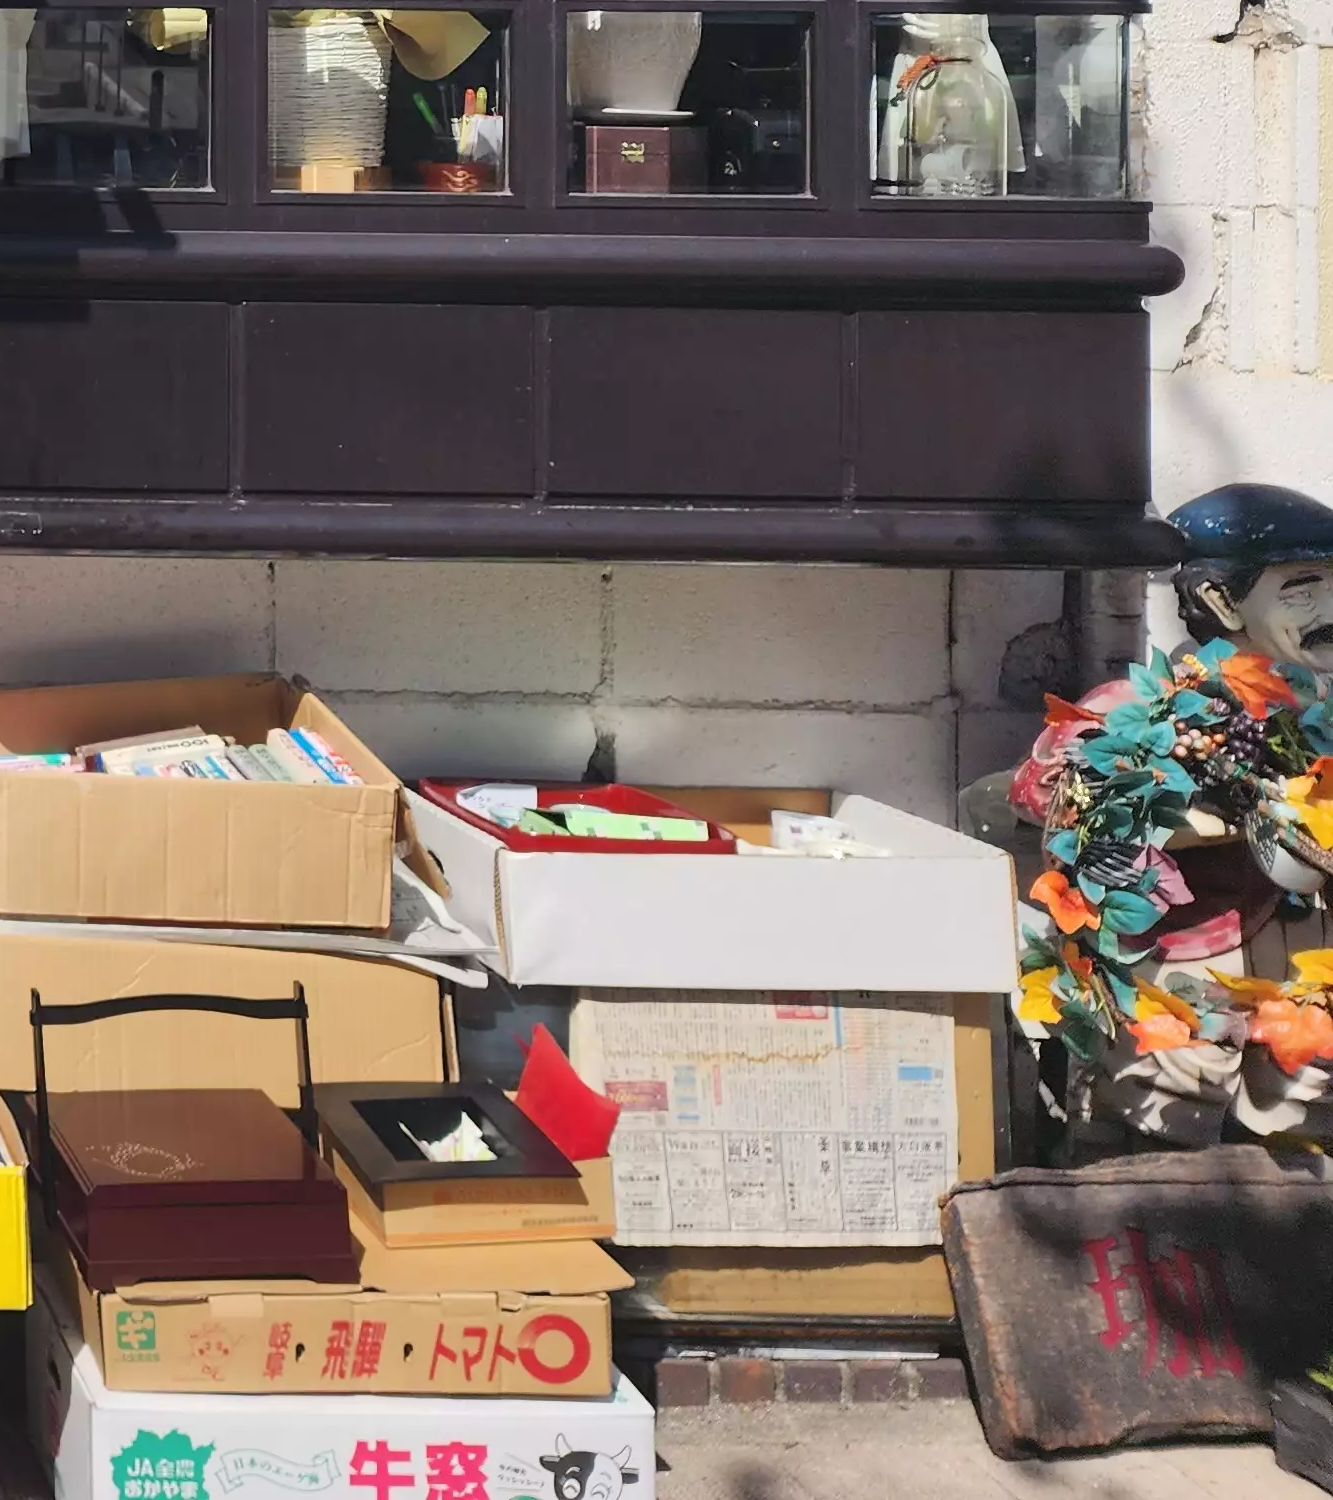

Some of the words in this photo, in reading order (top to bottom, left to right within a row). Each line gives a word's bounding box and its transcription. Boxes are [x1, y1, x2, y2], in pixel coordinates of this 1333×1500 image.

[262, 1321, 293, 1381] 岐阜
[428, 1322, 519, 1382] トマト
[126, 1456, 196, 1479] JA全農
[123, 1479, 199, 1500] おかやま
